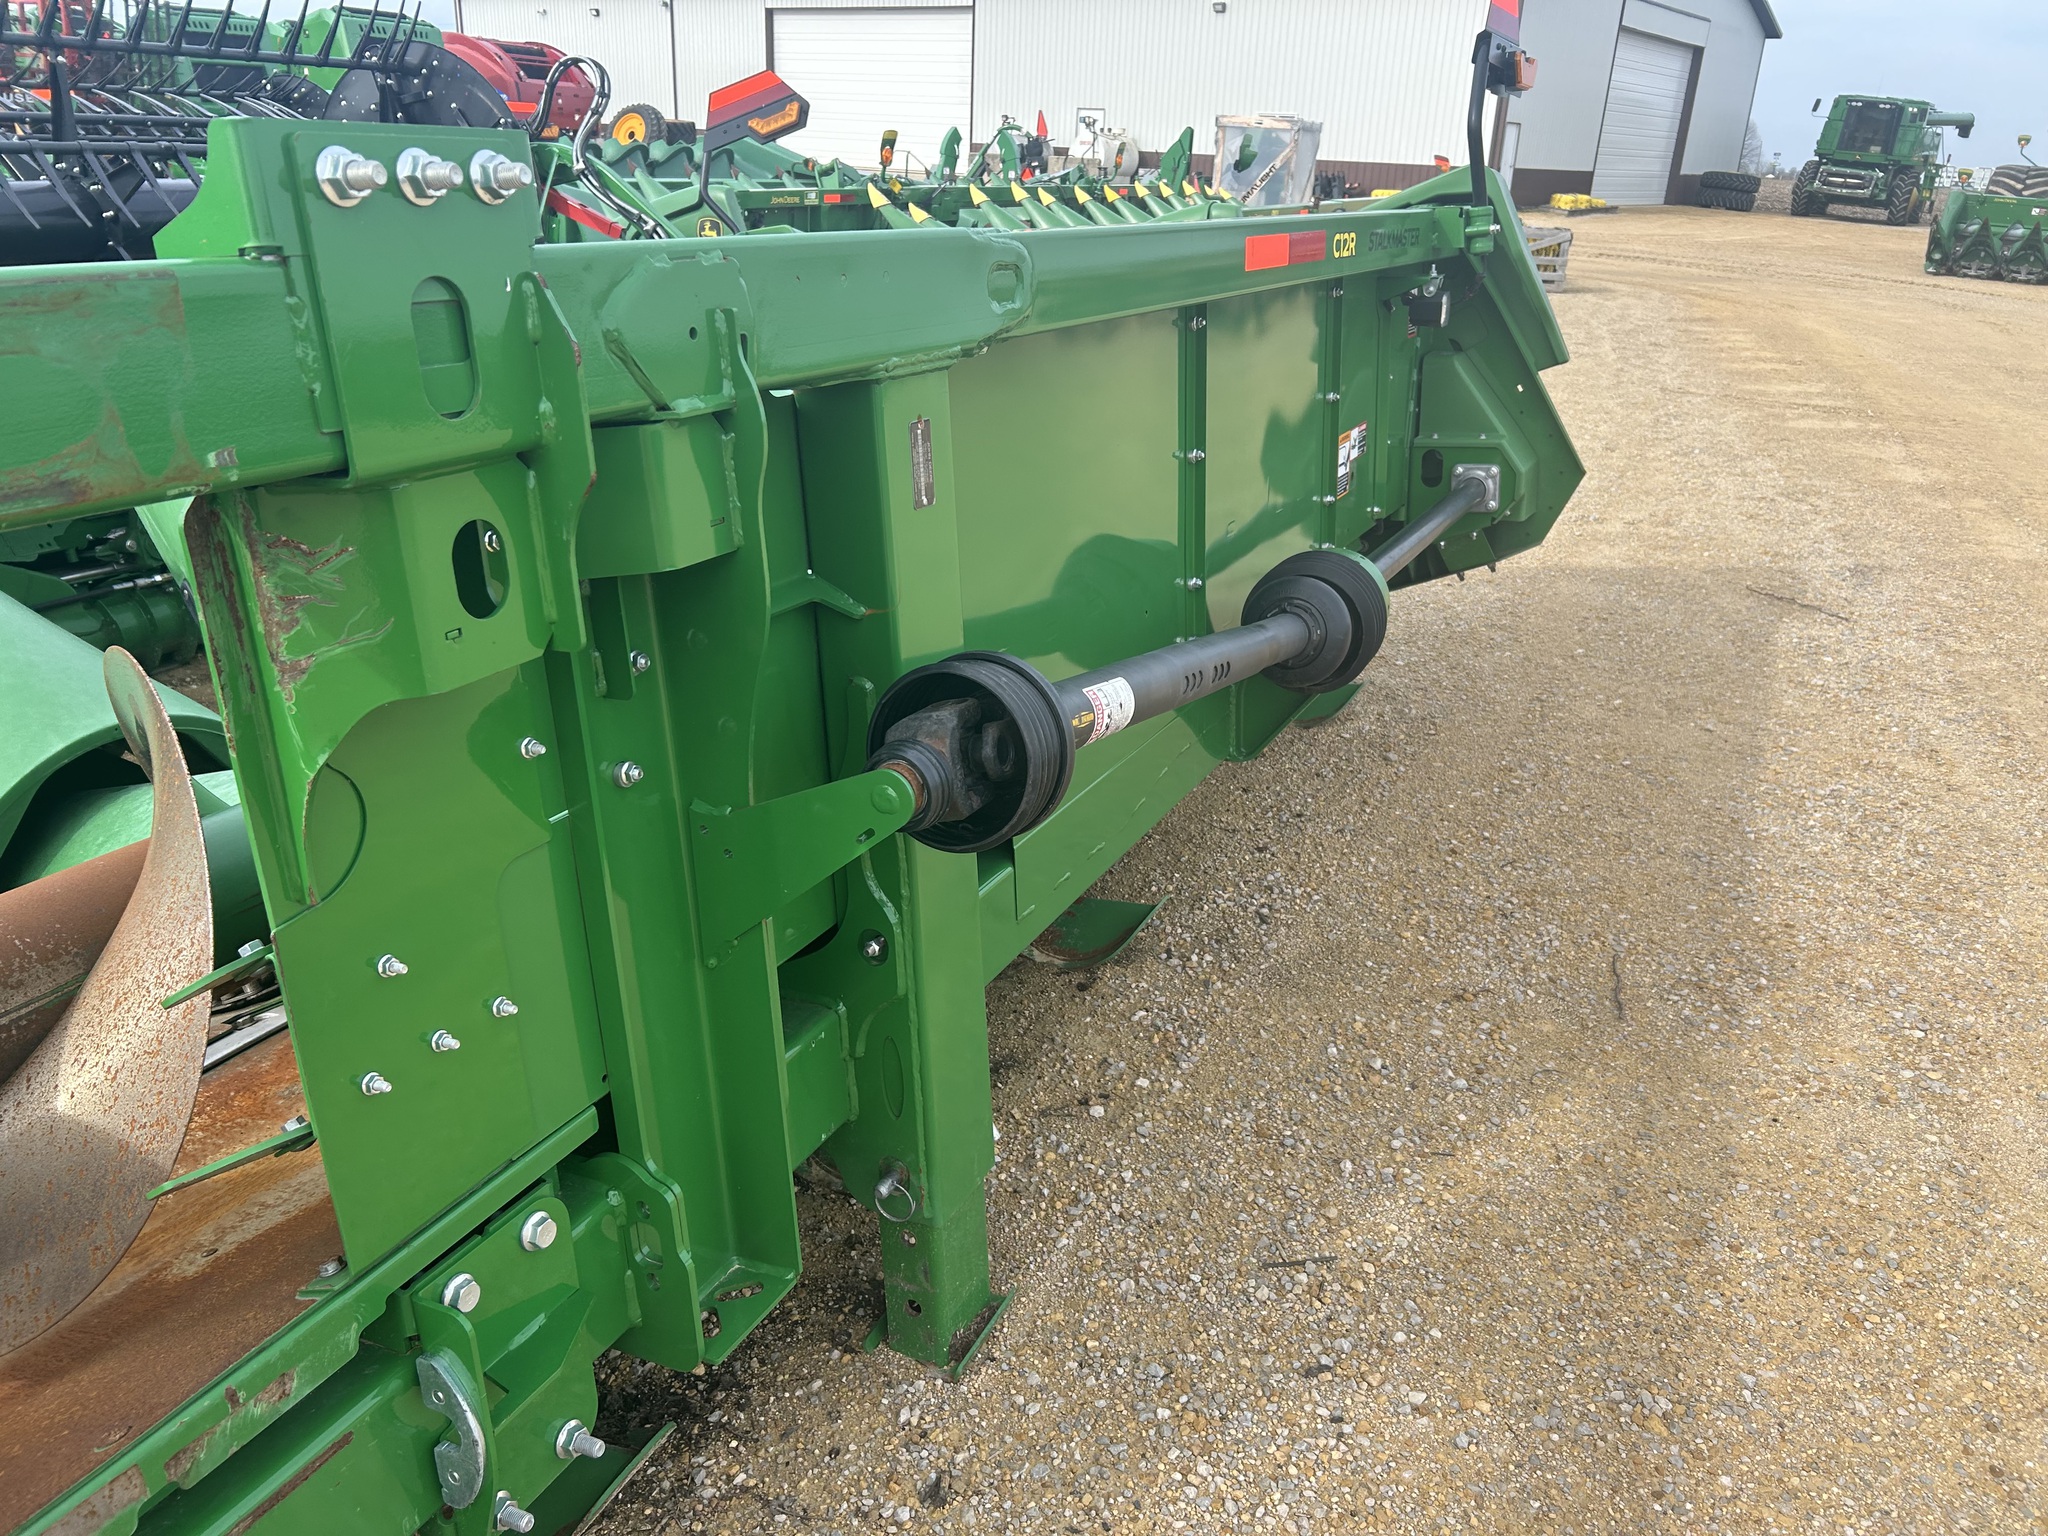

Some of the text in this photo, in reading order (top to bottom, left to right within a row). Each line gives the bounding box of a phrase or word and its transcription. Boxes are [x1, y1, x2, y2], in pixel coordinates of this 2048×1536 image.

[1333, 227, 1420, 258] C12R STALKMASTER
[1086, 689, 1104, 738] DANGER
